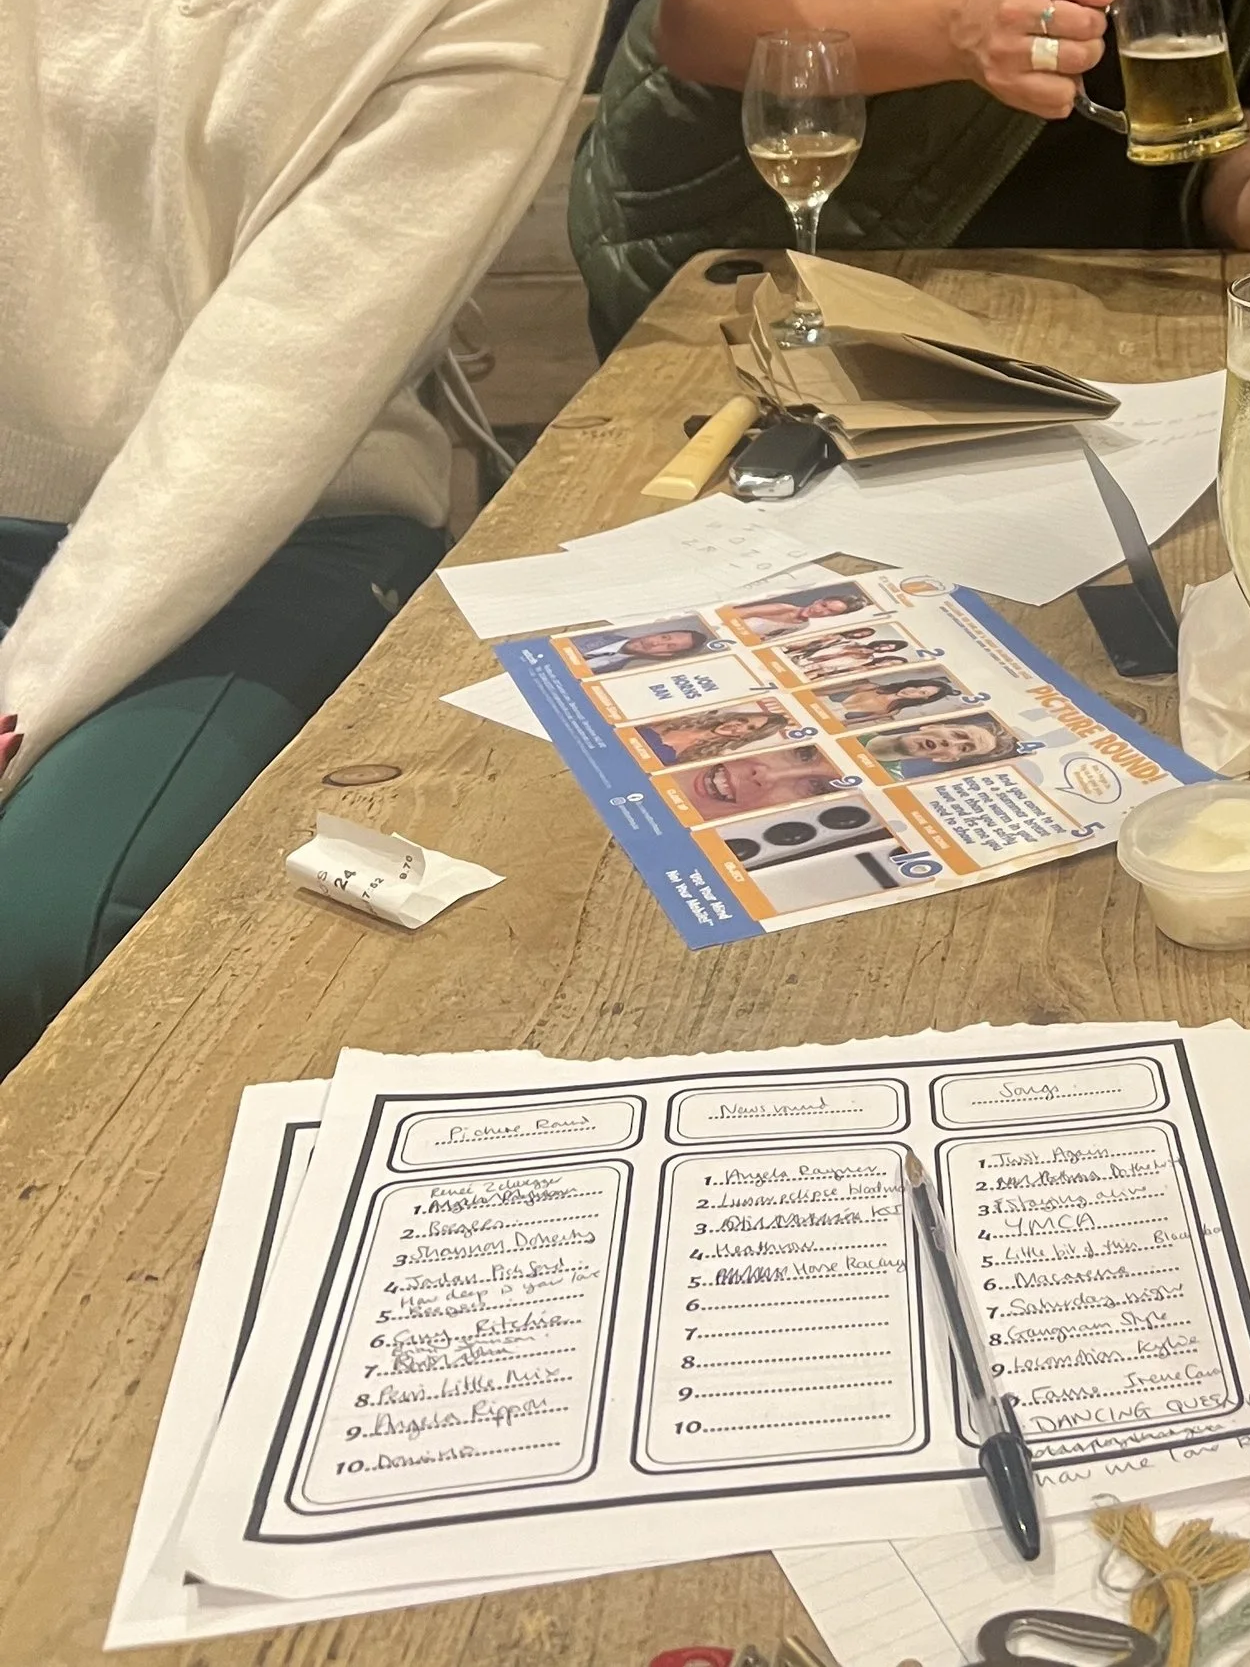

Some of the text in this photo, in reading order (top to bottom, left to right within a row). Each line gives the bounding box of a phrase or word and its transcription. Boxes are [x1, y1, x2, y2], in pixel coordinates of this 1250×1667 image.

[706, 638, 737, 652] 6
[916, 647, 945, 661] 2
[648, 682, 673, 702] BAN
[670, 673, 703, 700] HORNS
[694, 675, 719, 693] JOIN
[749, 681, 778, 692] 7
[962, 692, 992, 705] 3
[788, 725, 819, 740] 8
[1027, 685, 1102, 739] PICTURE
[1089, 733, 1170, 785] ROUND!
[1016, 741, 1047, 754] 4
[829, 775, 864, 789] 9
[1070, 821, 1105, 838] 5
[890, 849, 943, 879] 10
[334, 870, 357, 891] 24
[999, 1082, 1060, 1101] Songs
[1052, 1146, 1110, 1164] Again
[726, 1165, 877, 1187] Angela Rayner
[780, 1187, 838, 1206] eclipse
[1004, 1213, 1096, 1234] YMCA
[716, 1240, 816, 1257] Heathrow
[1053, 1242, 1077, 1258] bit
[793, 1260, 838, 1275] Horse
[846, 1258, 907, 1273] Racing
[446, 1288, 488, 1303] deep
[1010, 1293, 1116, 1315] Saturday
[475, 1311, 570, 1333] Ritchie
[1007, 1322, 1112, 1344] Gangnam
[506, 1367, 560, 1383] Mix
[1029, 1402, 1151, 1431] DANCING
[1105, 1458, 1151, 1476] me
